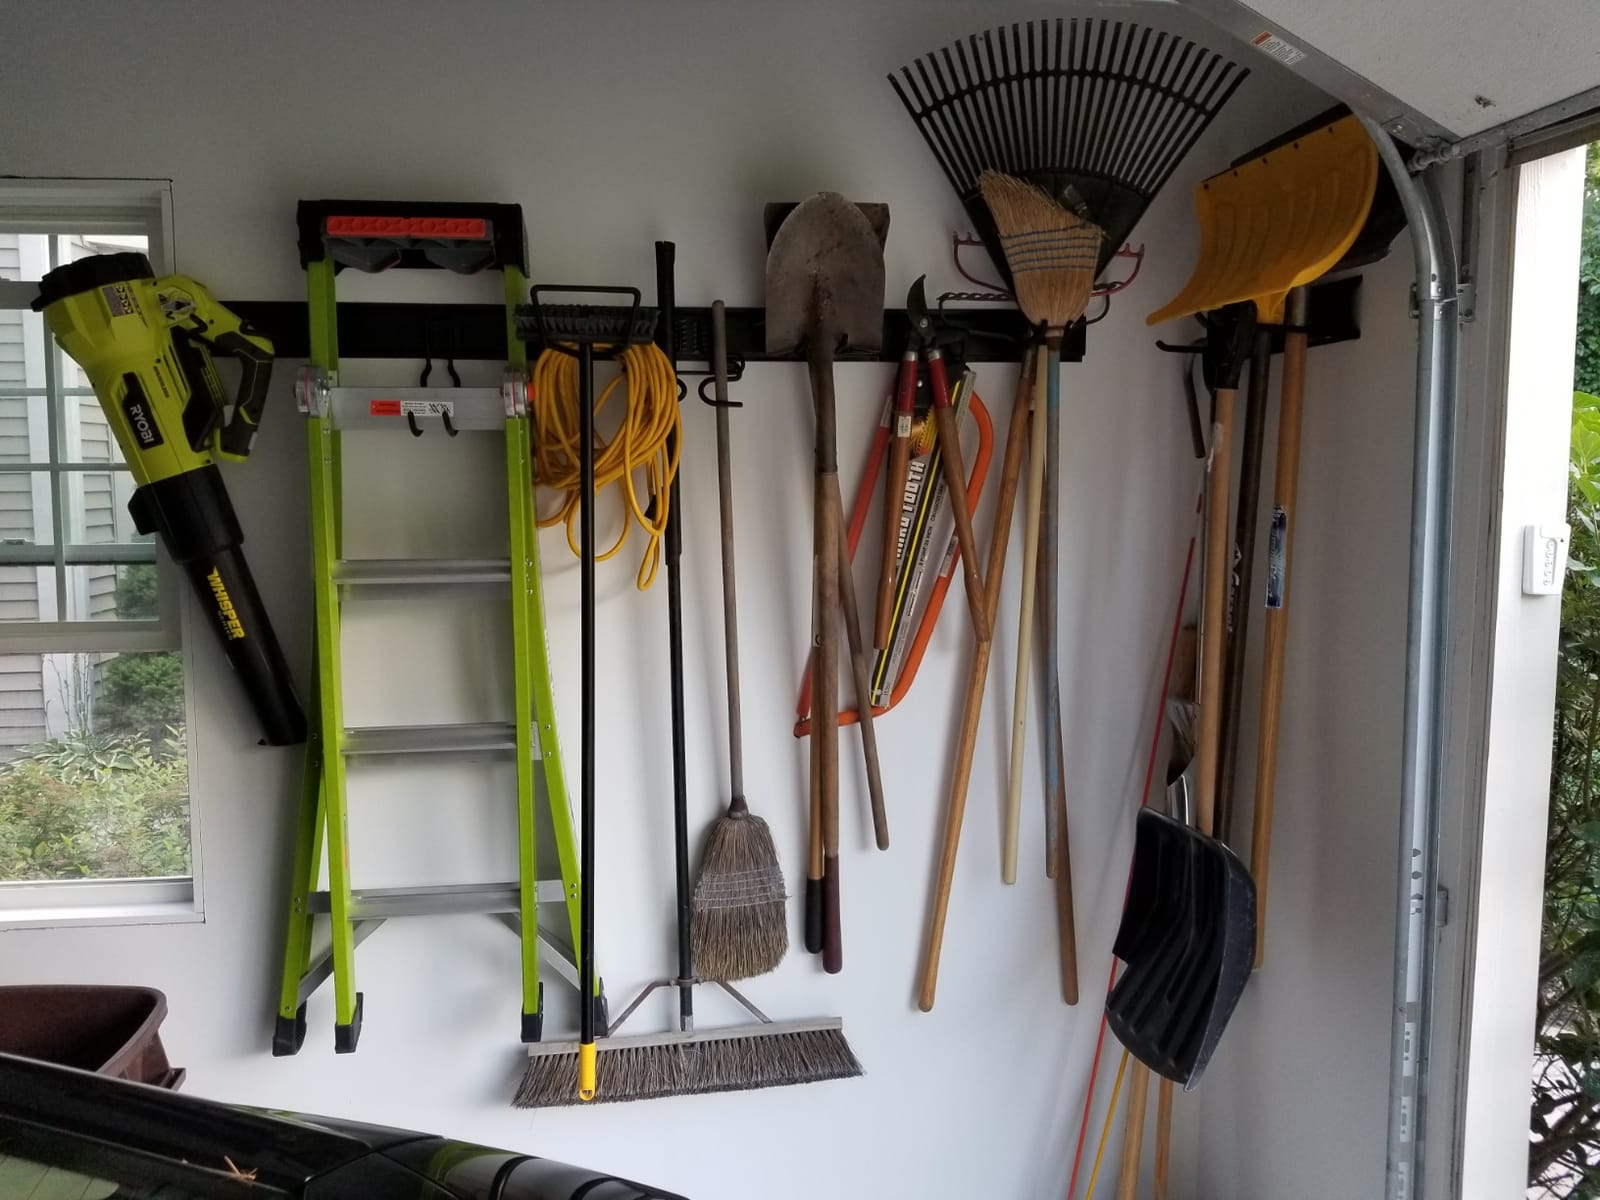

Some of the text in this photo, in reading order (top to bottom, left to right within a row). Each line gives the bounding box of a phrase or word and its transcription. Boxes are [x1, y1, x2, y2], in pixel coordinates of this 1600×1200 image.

[130, 404, 154, 443] RYOBI
[903, 461, 926, 512] TOOTH
[207, 566, 245, 638] WHISPER
